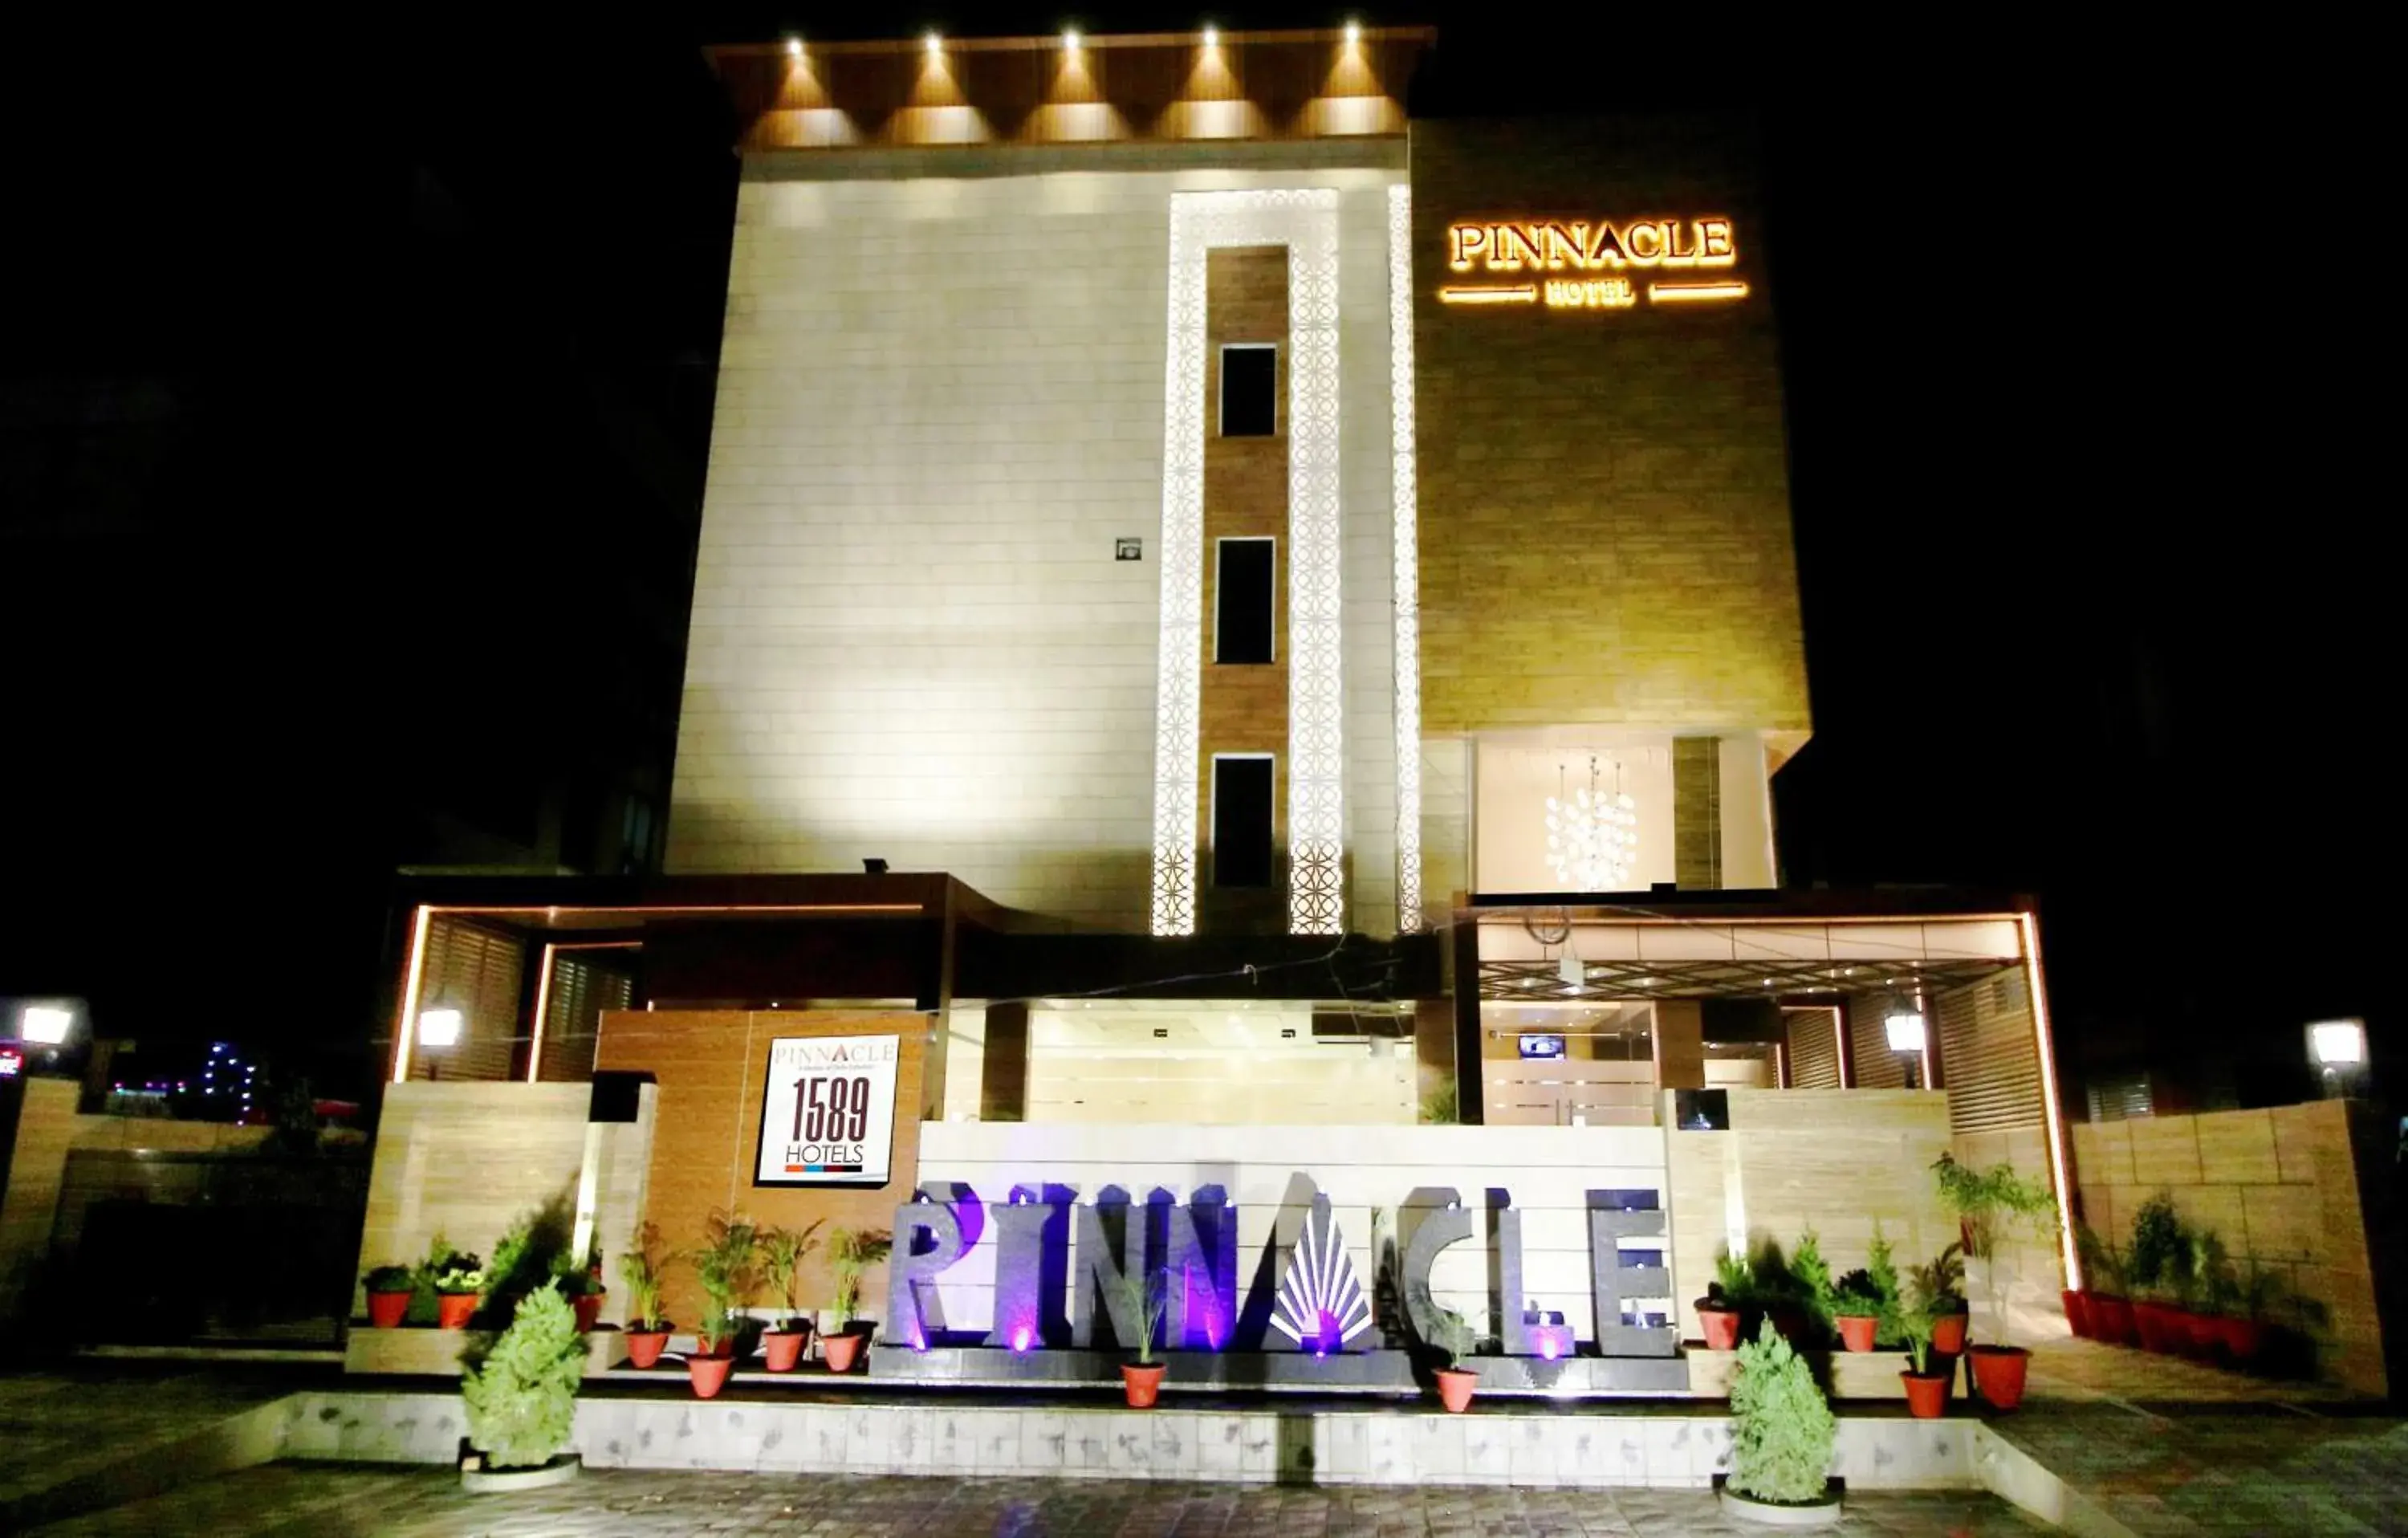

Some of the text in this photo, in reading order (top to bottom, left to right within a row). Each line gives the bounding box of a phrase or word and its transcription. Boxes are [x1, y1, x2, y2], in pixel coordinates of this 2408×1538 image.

[1453, 218, 1735, 268] PINNACLE
[1546, 280, 1635, 306] HOTEL
[775, 1044, 895, 1064] PINNACLE
[793, 1076, 869, 1141] 1589
[786, 1144, 864, 1163] HOTELS
[883, 1193, 1675, 1356] PINNACLE
